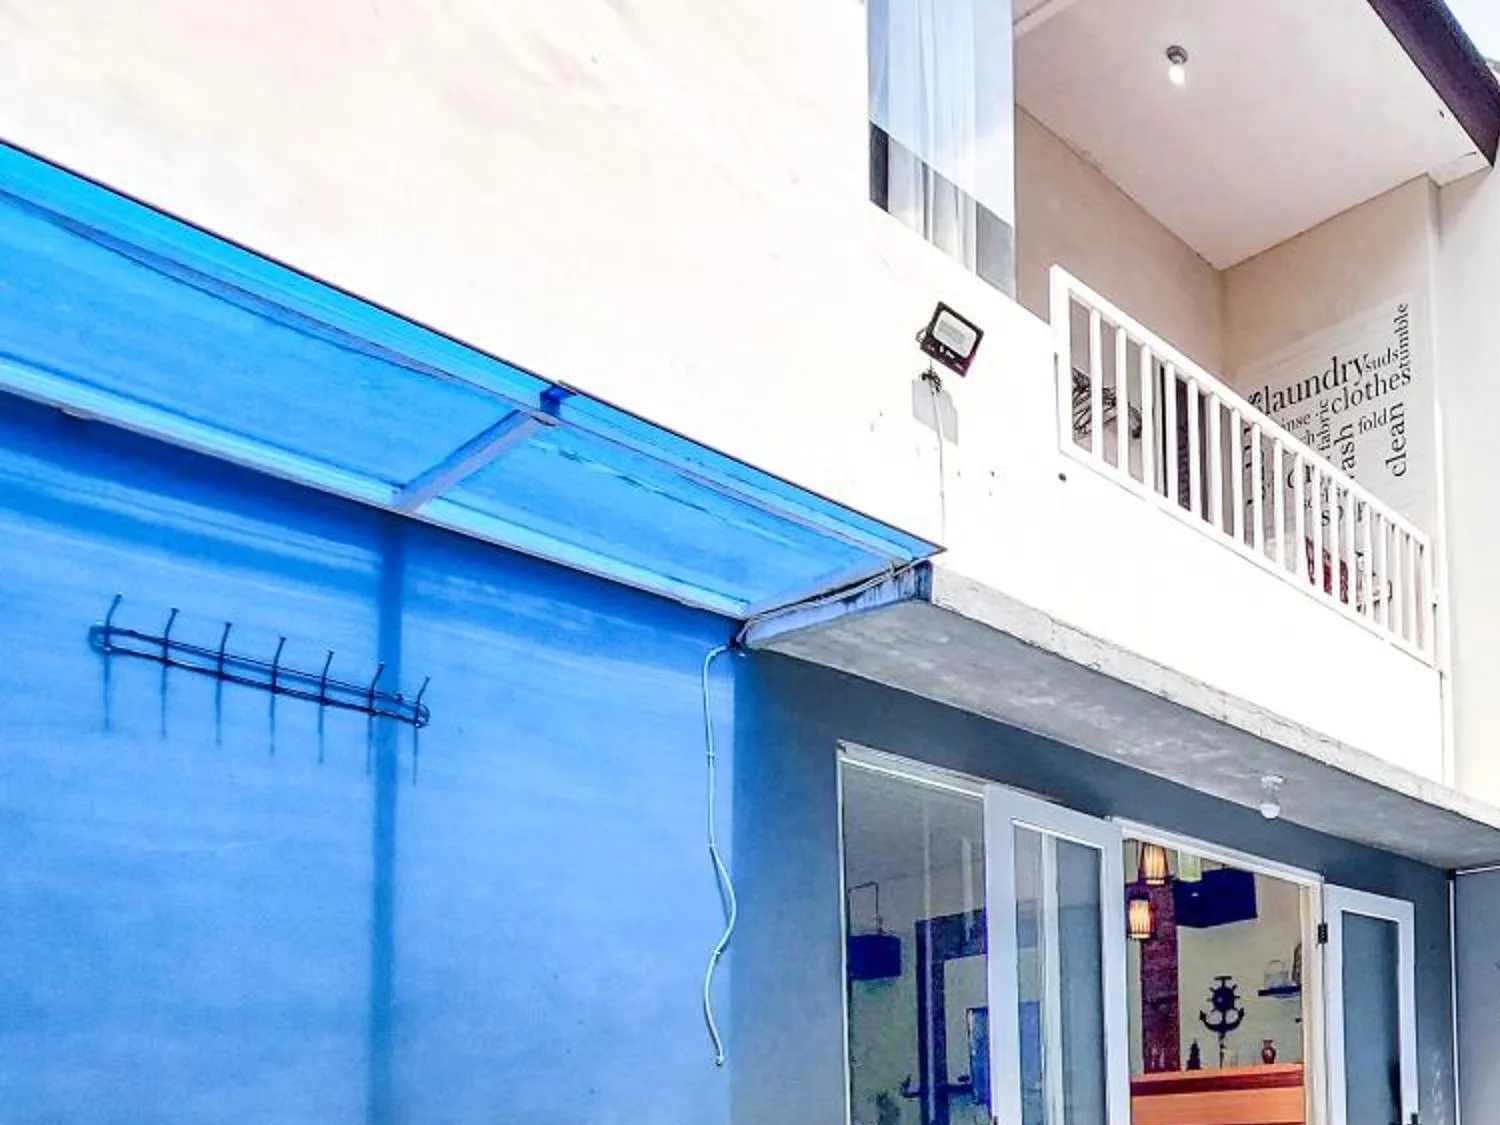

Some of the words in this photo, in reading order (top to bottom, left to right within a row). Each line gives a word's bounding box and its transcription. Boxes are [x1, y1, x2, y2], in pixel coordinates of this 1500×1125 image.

[1265, 353, 1370, 416] laundry
[1331, 367, 1411, 415] clothes
[1357, 407, 1388, 435] fold
[1385, 401, 1407, 478] clean
[1333, 423, 1356, 480] ash
